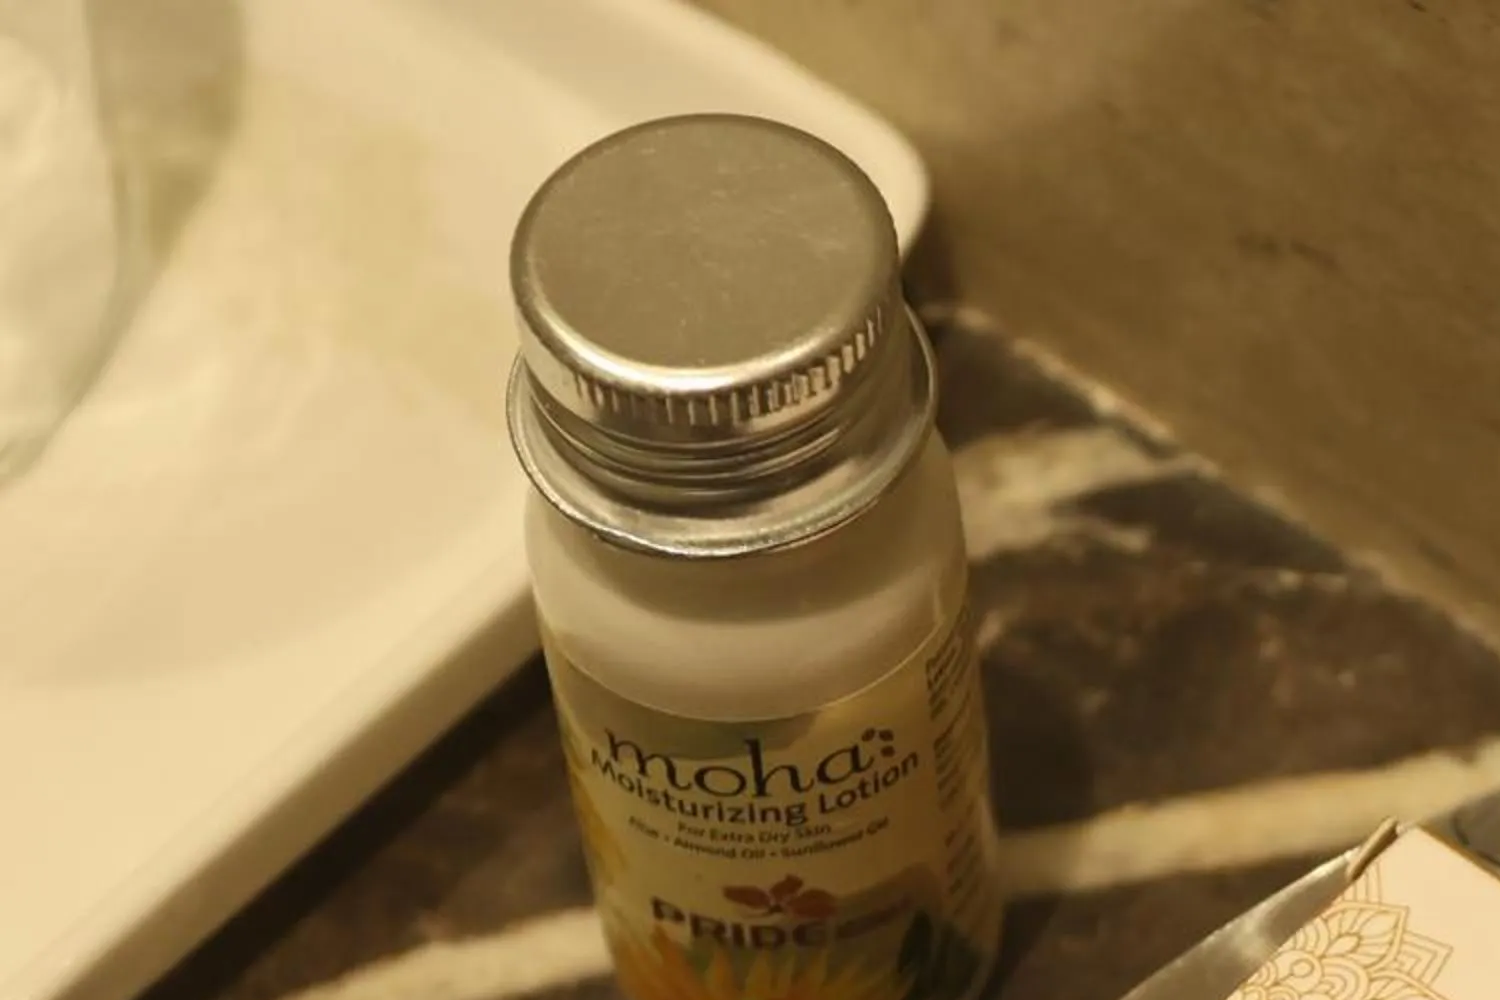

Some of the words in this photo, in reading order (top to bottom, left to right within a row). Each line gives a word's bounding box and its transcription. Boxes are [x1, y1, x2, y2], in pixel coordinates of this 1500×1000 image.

[591, 747, 808, 827] Moisturizing
[818, 751, 919, 815] Lotion
[604, 728, 875, 798] moha
[652, 896, 828, 949] PRIDE
